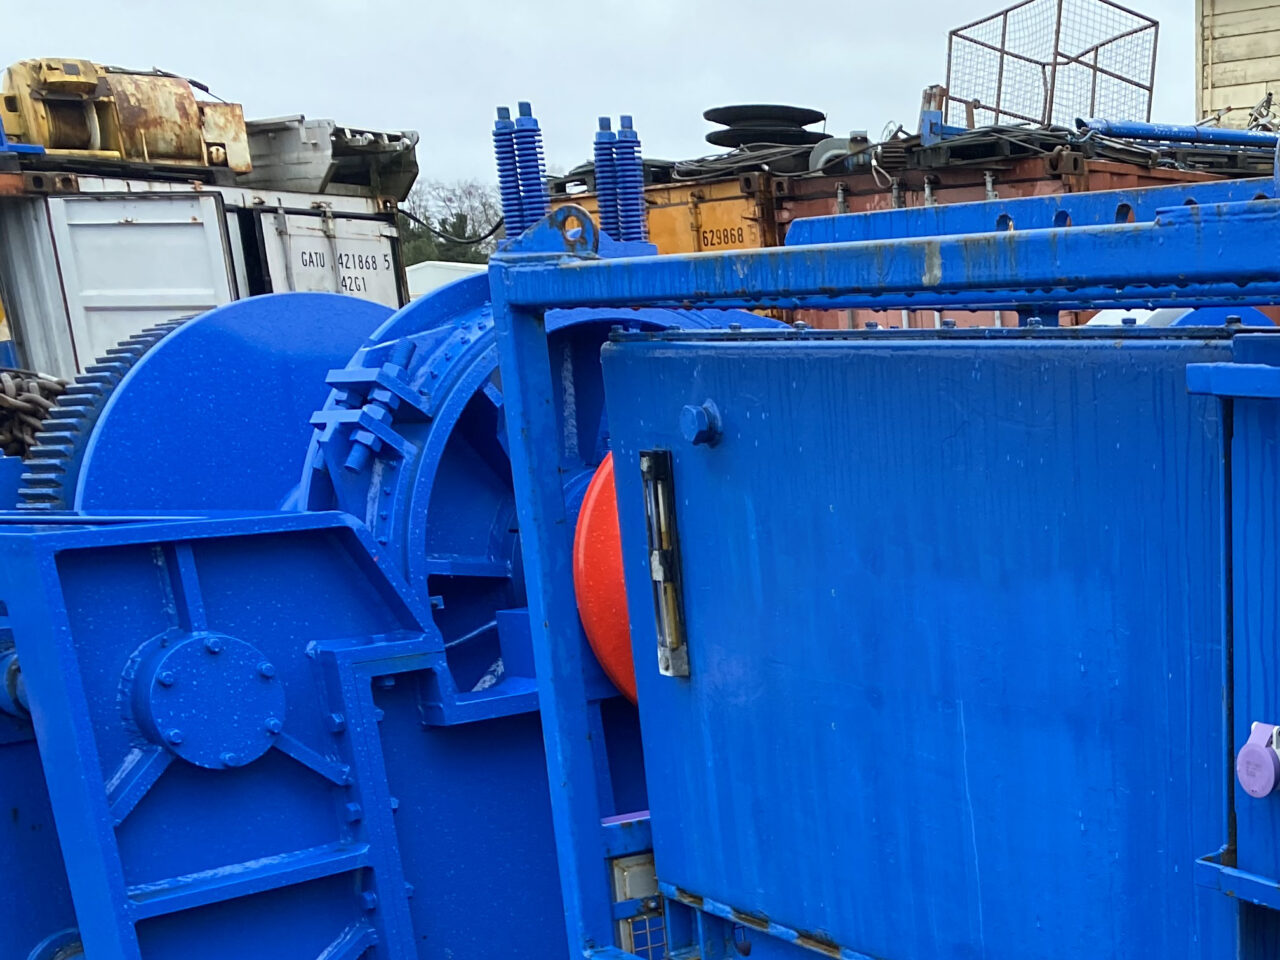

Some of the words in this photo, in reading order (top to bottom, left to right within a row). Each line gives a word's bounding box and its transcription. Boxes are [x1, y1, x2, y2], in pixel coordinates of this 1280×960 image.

[702, 226, 744, 247] 629868
[301, 251, 325, 268] GATU
[337, 253, 378, 270] 421868
[383, 254, 391, 270] 5
[341, 276, 367, 292] 42G1
